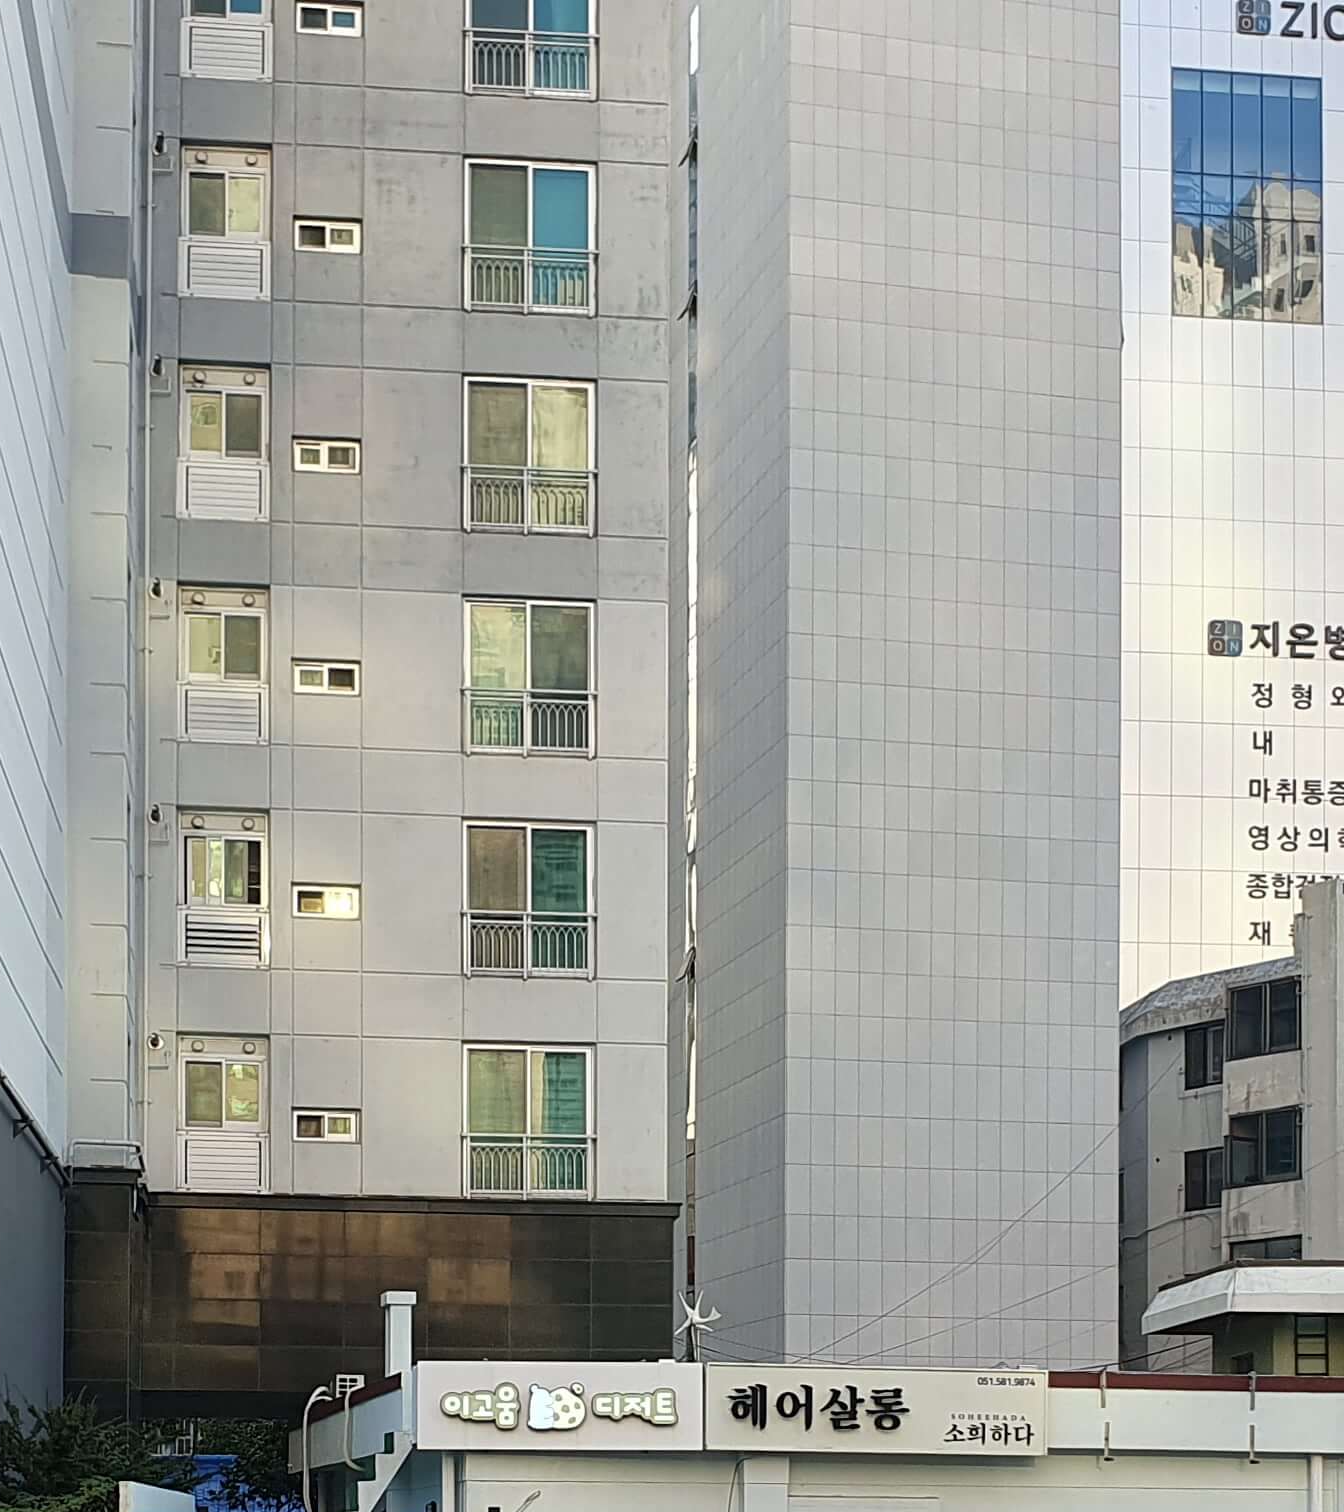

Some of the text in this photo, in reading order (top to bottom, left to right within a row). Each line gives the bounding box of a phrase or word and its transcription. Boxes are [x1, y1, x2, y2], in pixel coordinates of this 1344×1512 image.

[441, 1383, 678, 1429] 이고움 디저트
[727, 1384, 910, 1431] 헤어살롱
[944, 1422, 1035, 1446] 소희하다
